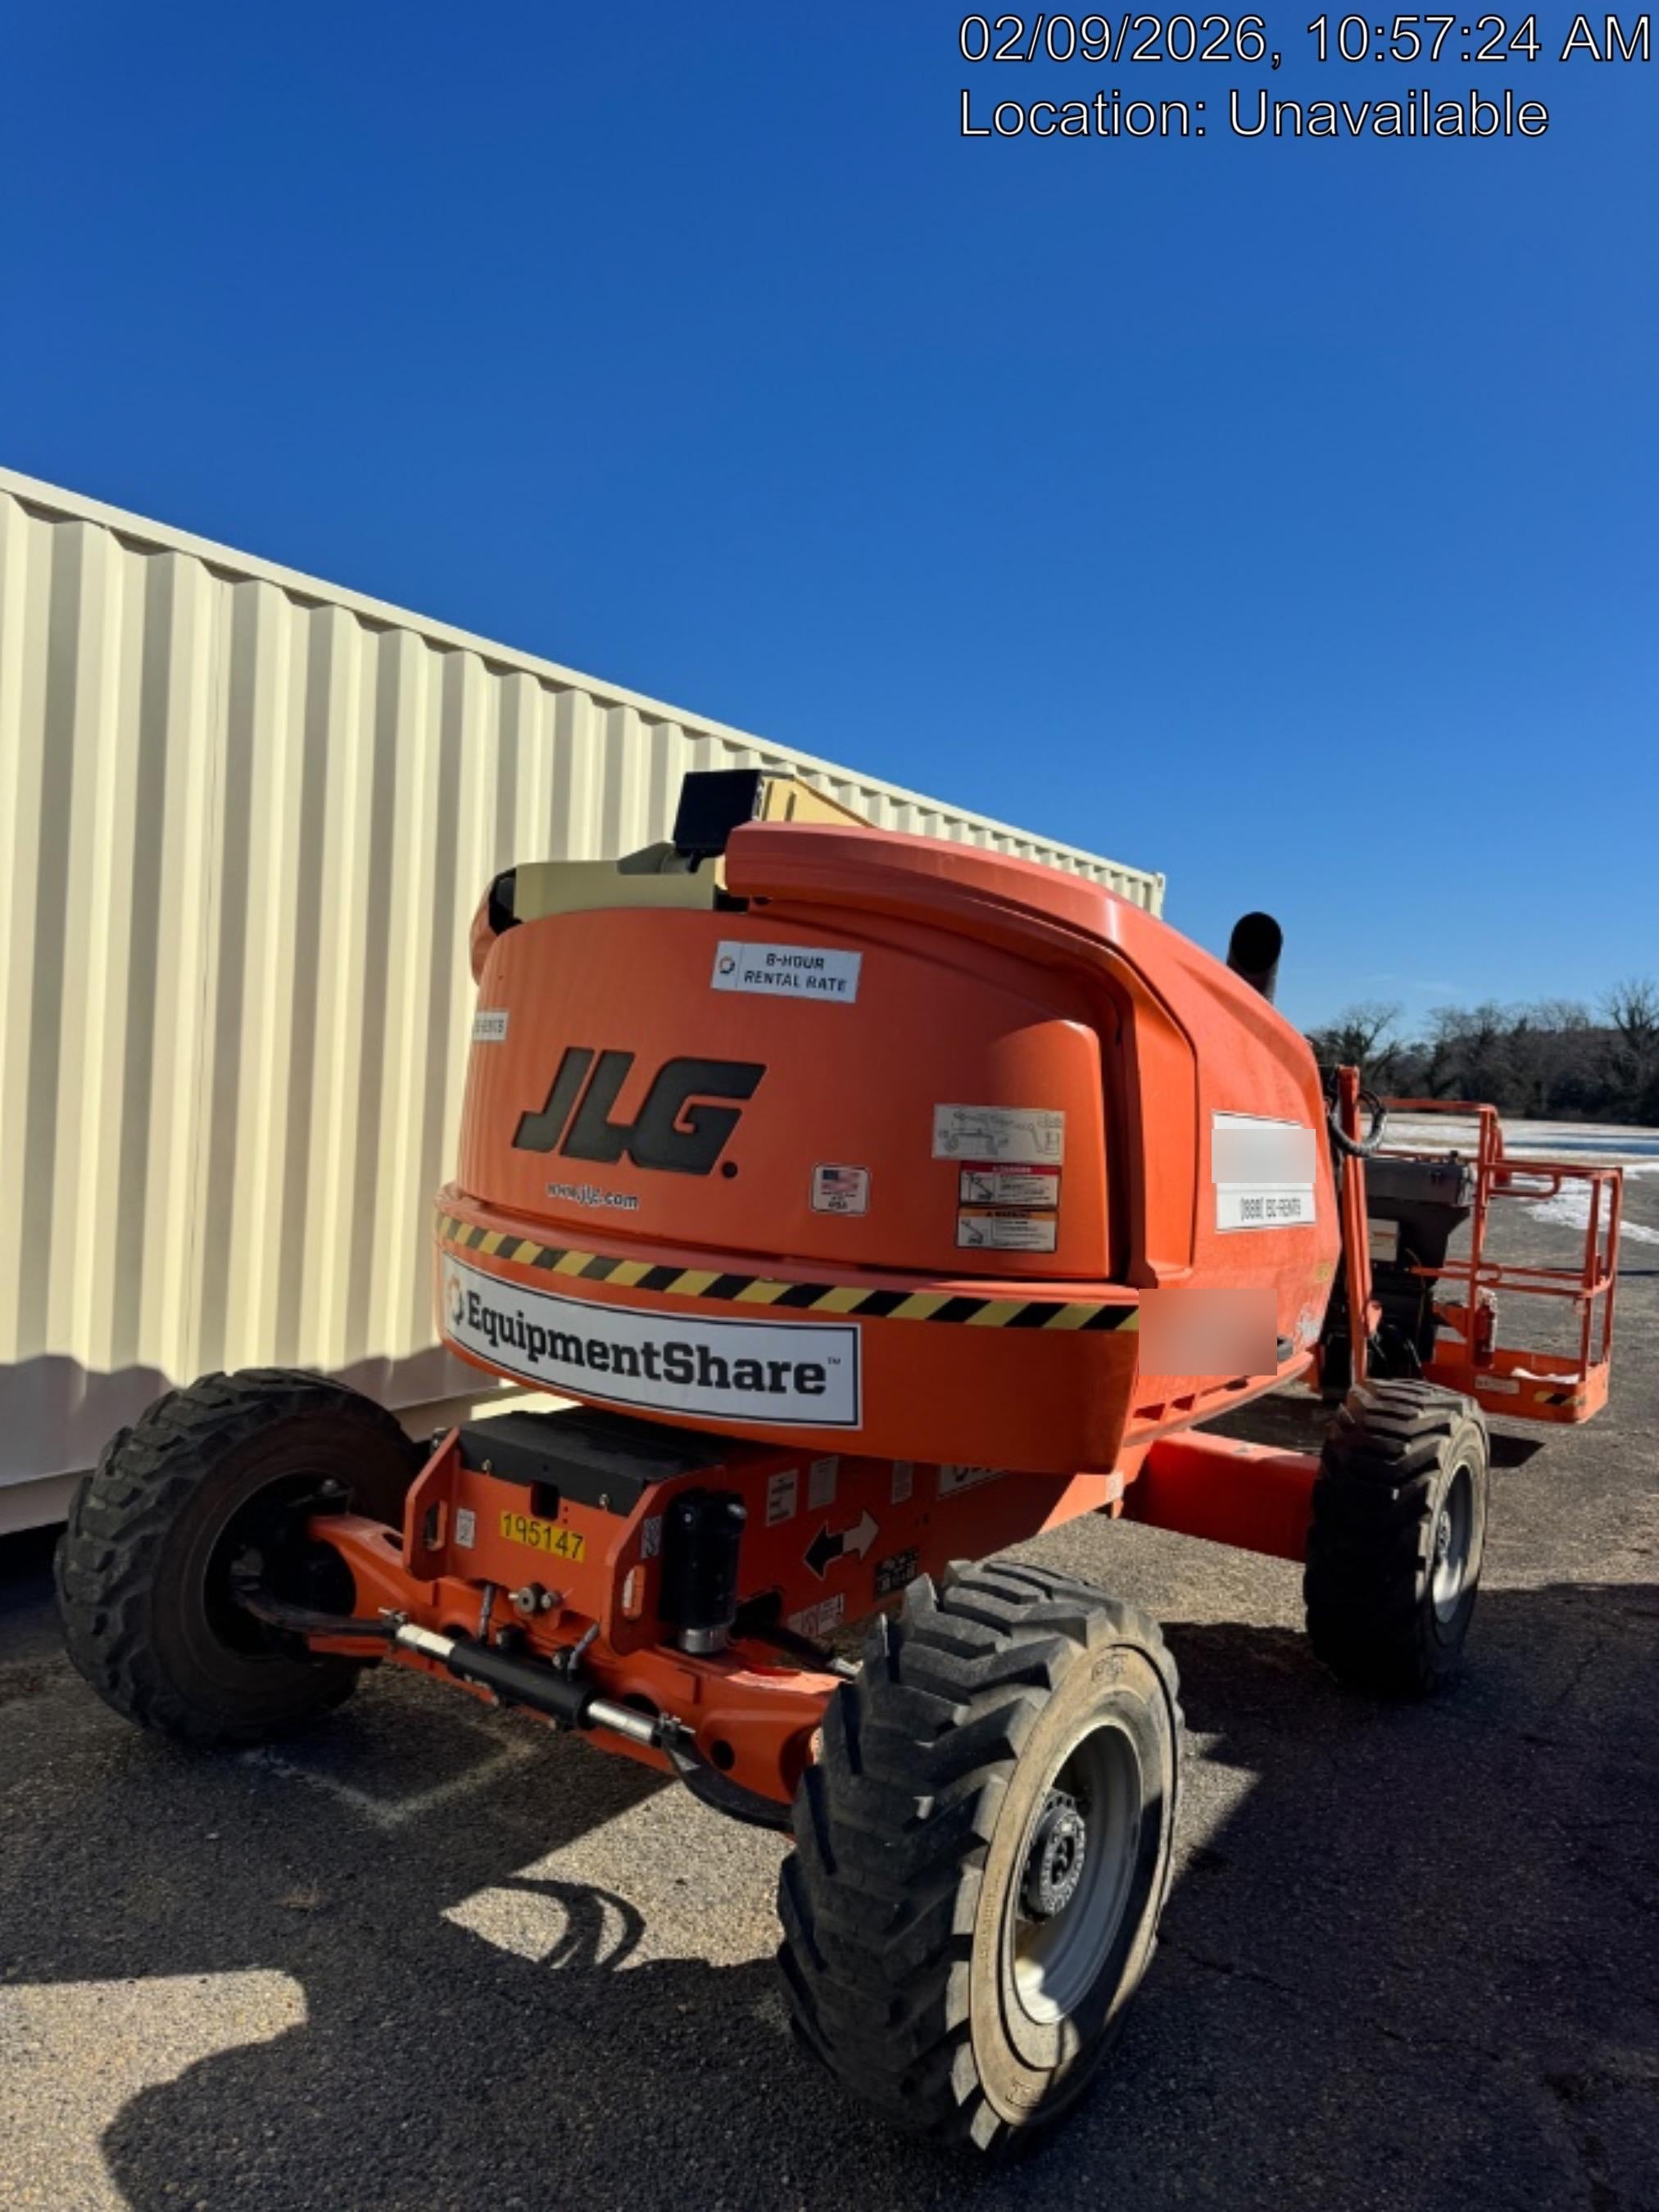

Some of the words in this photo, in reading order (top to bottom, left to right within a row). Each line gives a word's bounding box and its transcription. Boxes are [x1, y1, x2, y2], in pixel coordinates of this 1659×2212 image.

[744, 970, 801, 988] RENTAL
[805, 977, 847, 992] RATE
[465, 1290, 827, 1396] EquipmentShare
[504, 1513, 583, 1559] 195147
